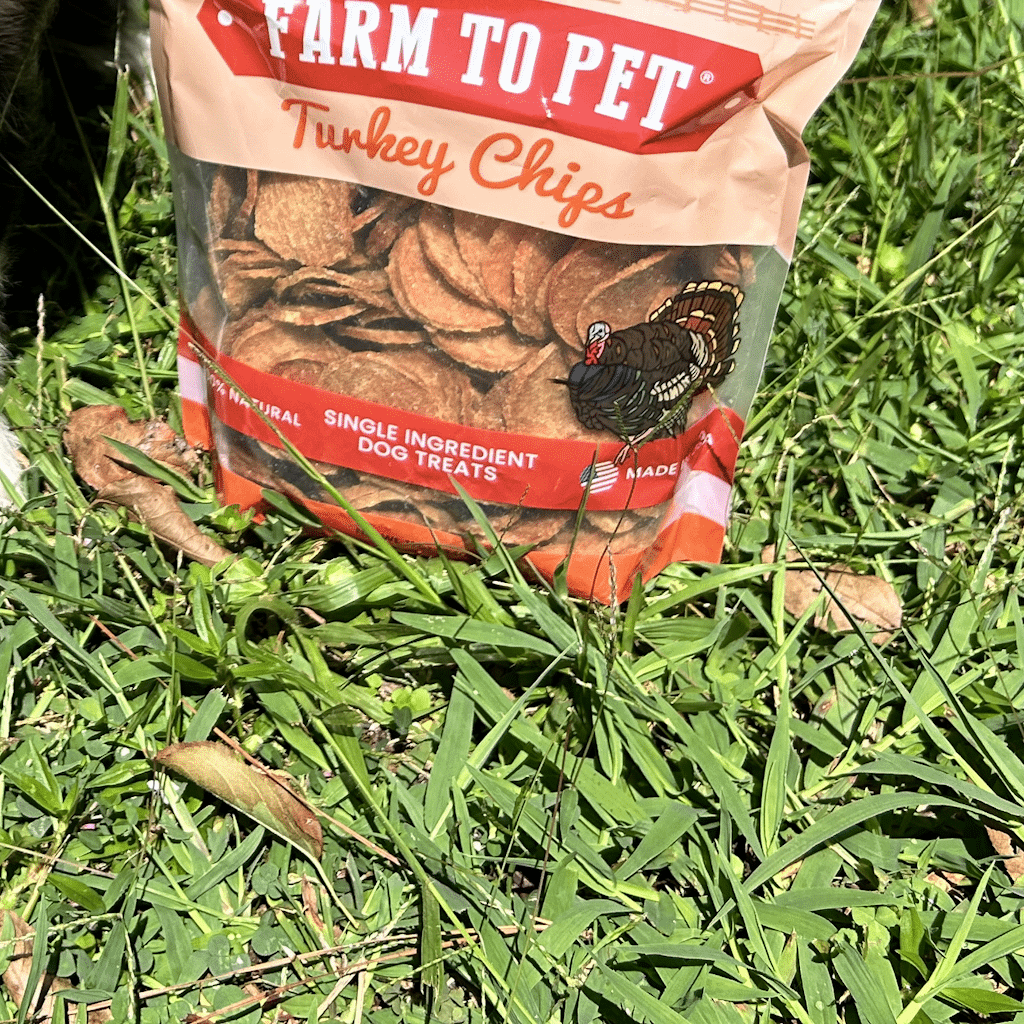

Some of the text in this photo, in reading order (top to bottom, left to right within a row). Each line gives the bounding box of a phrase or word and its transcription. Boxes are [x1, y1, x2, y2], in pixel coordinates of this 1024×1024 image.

[460, 11, 542, 95] TO
[281, 98, 635, 228] Turkey Chips
[324, 408, 539, 470] SINGLE INGREDIENT
[357, 436, 498, 482] DOG TREATS
[625, 462, 679, 480] MADE
